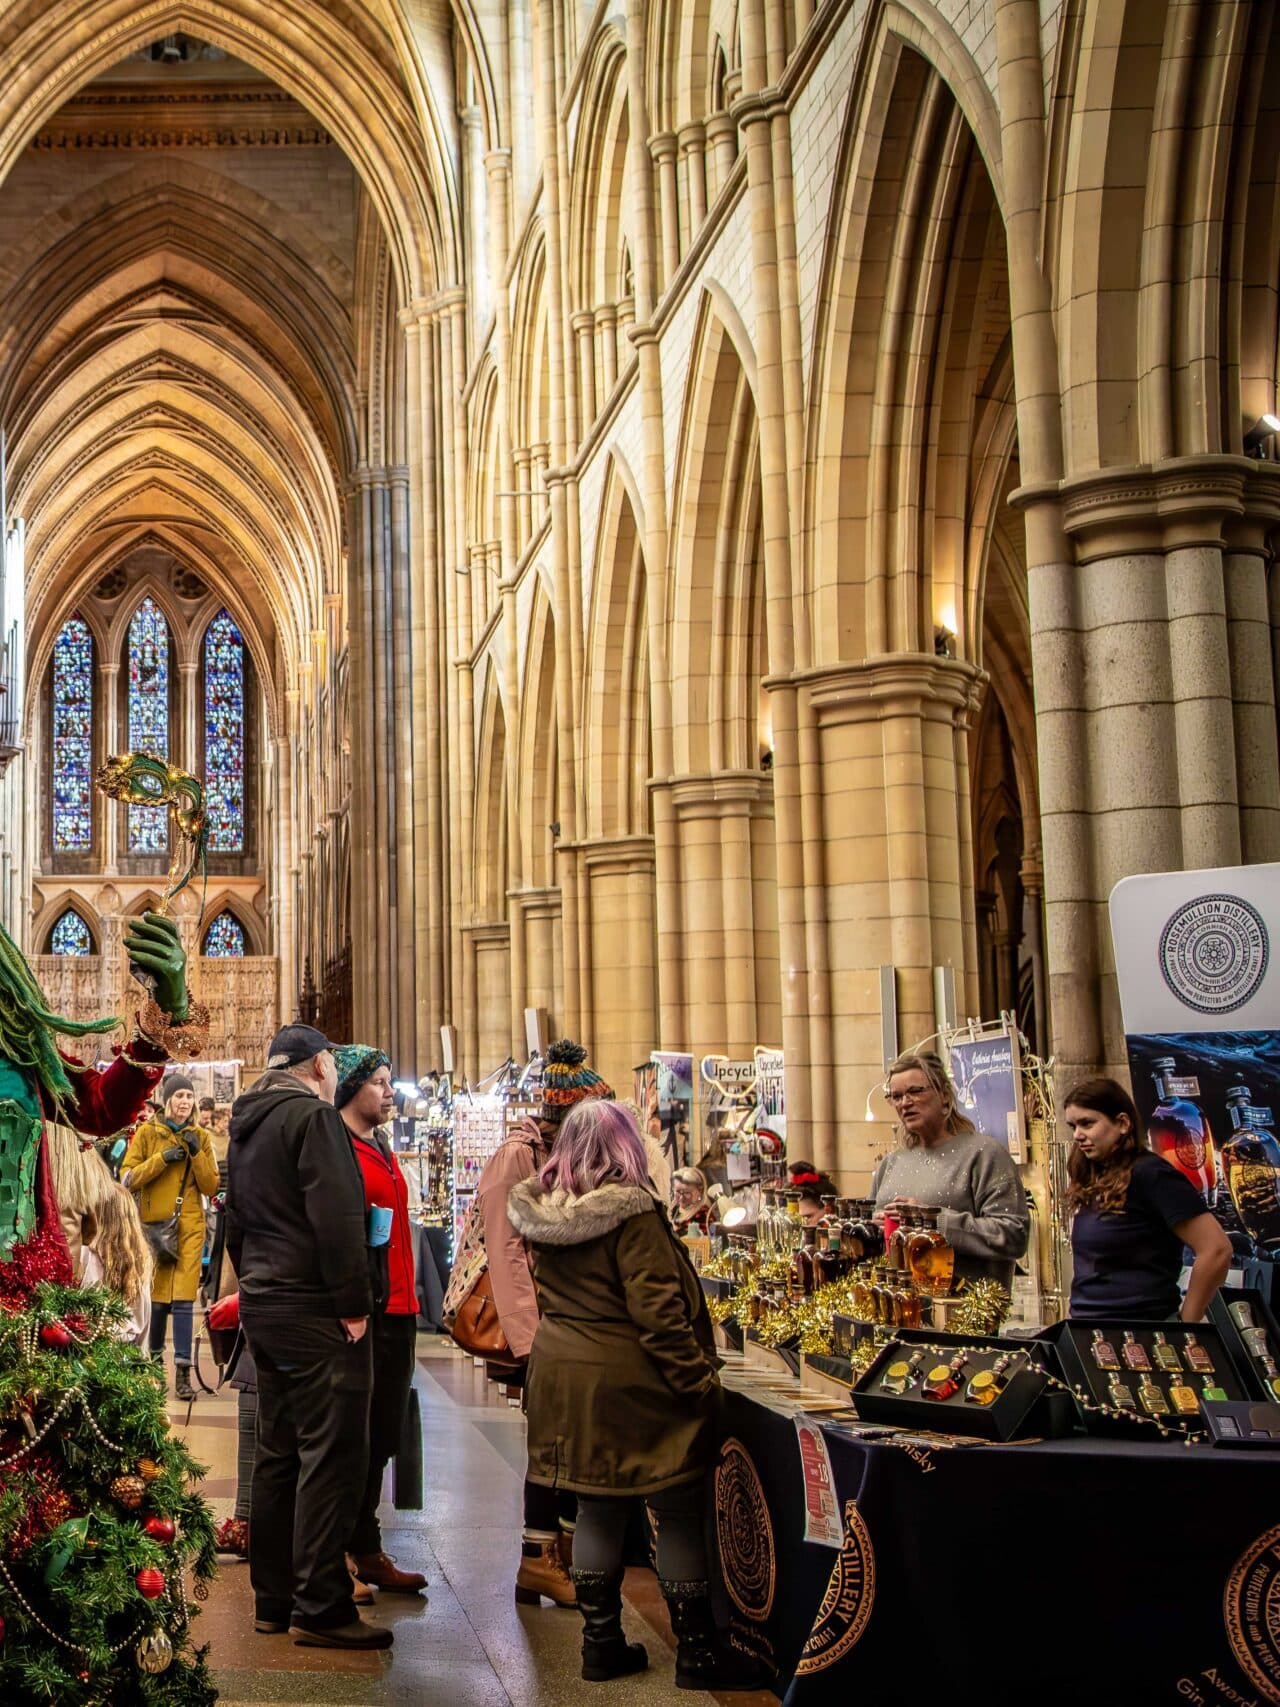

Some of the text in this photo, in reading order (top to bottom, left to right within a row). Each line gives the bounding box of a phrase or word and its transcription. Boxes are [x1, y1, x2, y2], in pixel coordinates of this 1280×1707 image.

[1167, 903, 1261, 953] ROSEMULLION DISTILLERY
[835, 1537, 862, 1625] STILLERY
